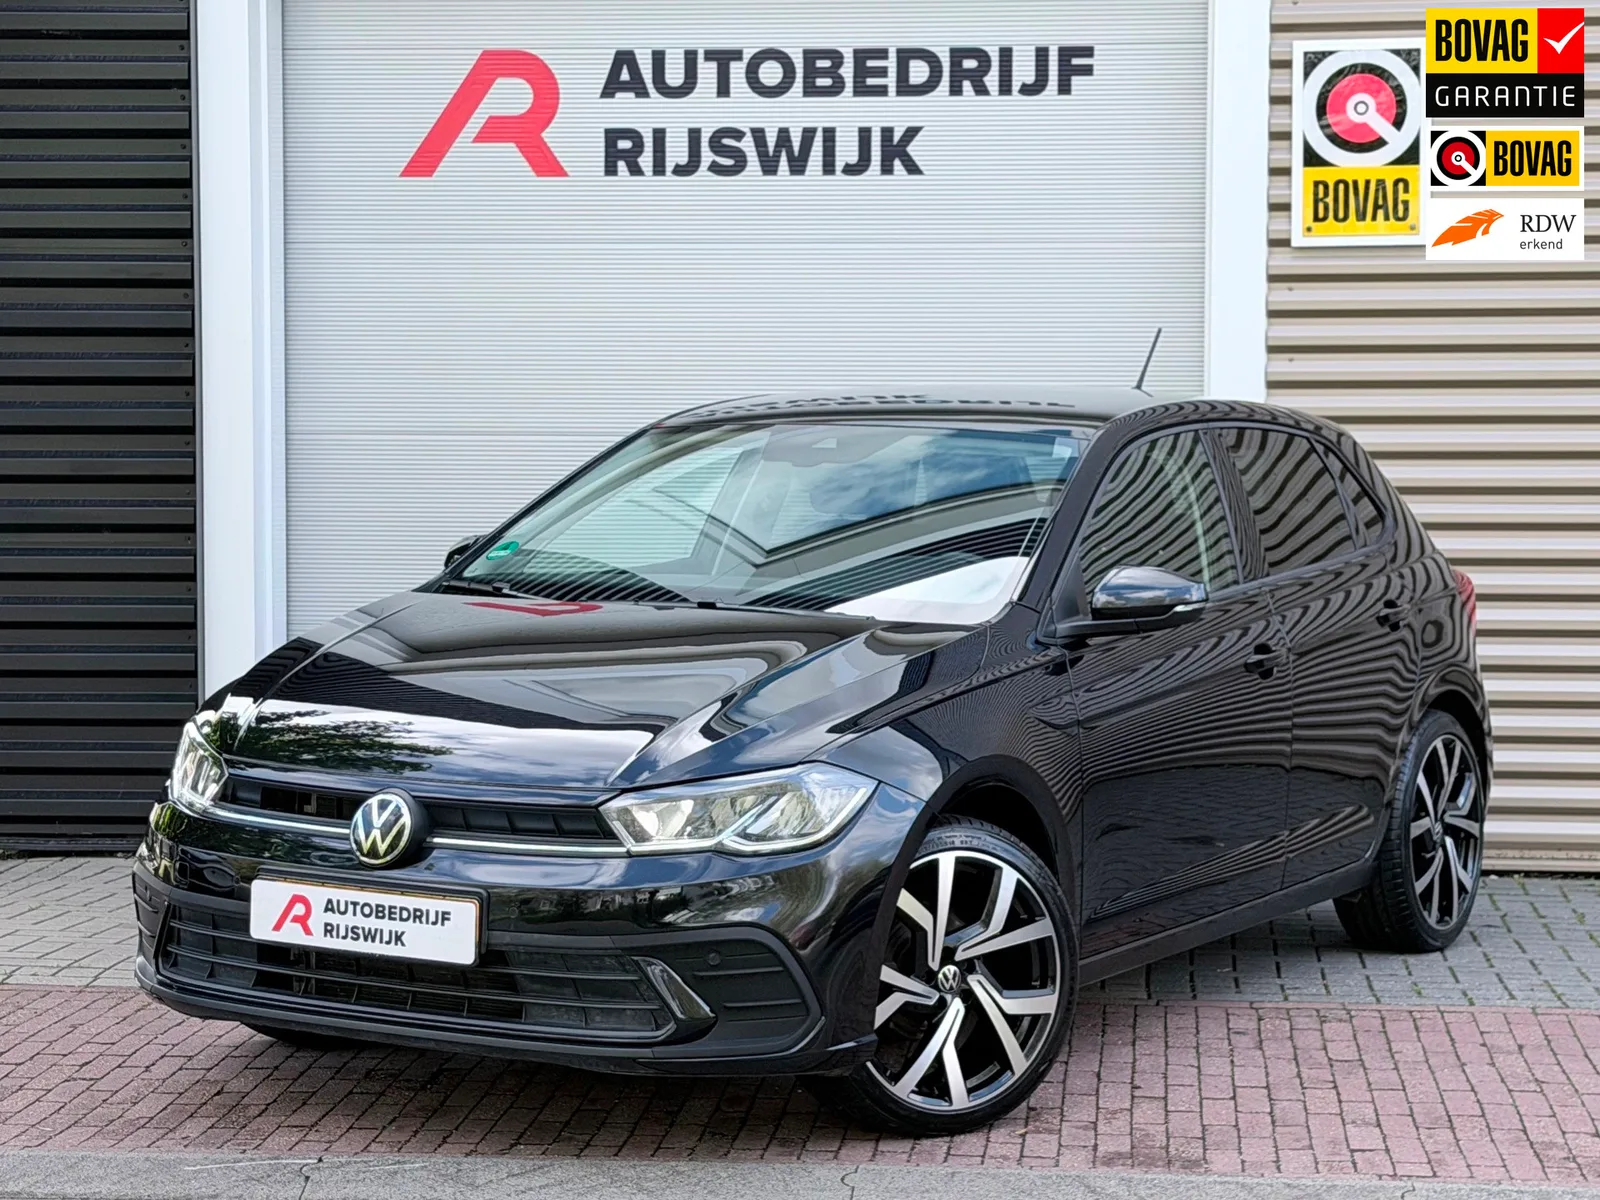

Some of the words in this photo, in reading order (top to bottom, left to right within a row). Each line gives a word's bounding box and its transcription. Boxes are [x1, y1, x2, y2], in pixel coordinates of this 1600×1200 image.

[600, 46, 1095, 98] AUTOBEDRIJF
[604, 126, 924, 177] RIJSWIJK
[1312, 178, 1410, 223] BOVAG
[323, 898, 452, 927] AUTOBEDRIJF
[323, 922, 407, 947] RIJSWIJK
